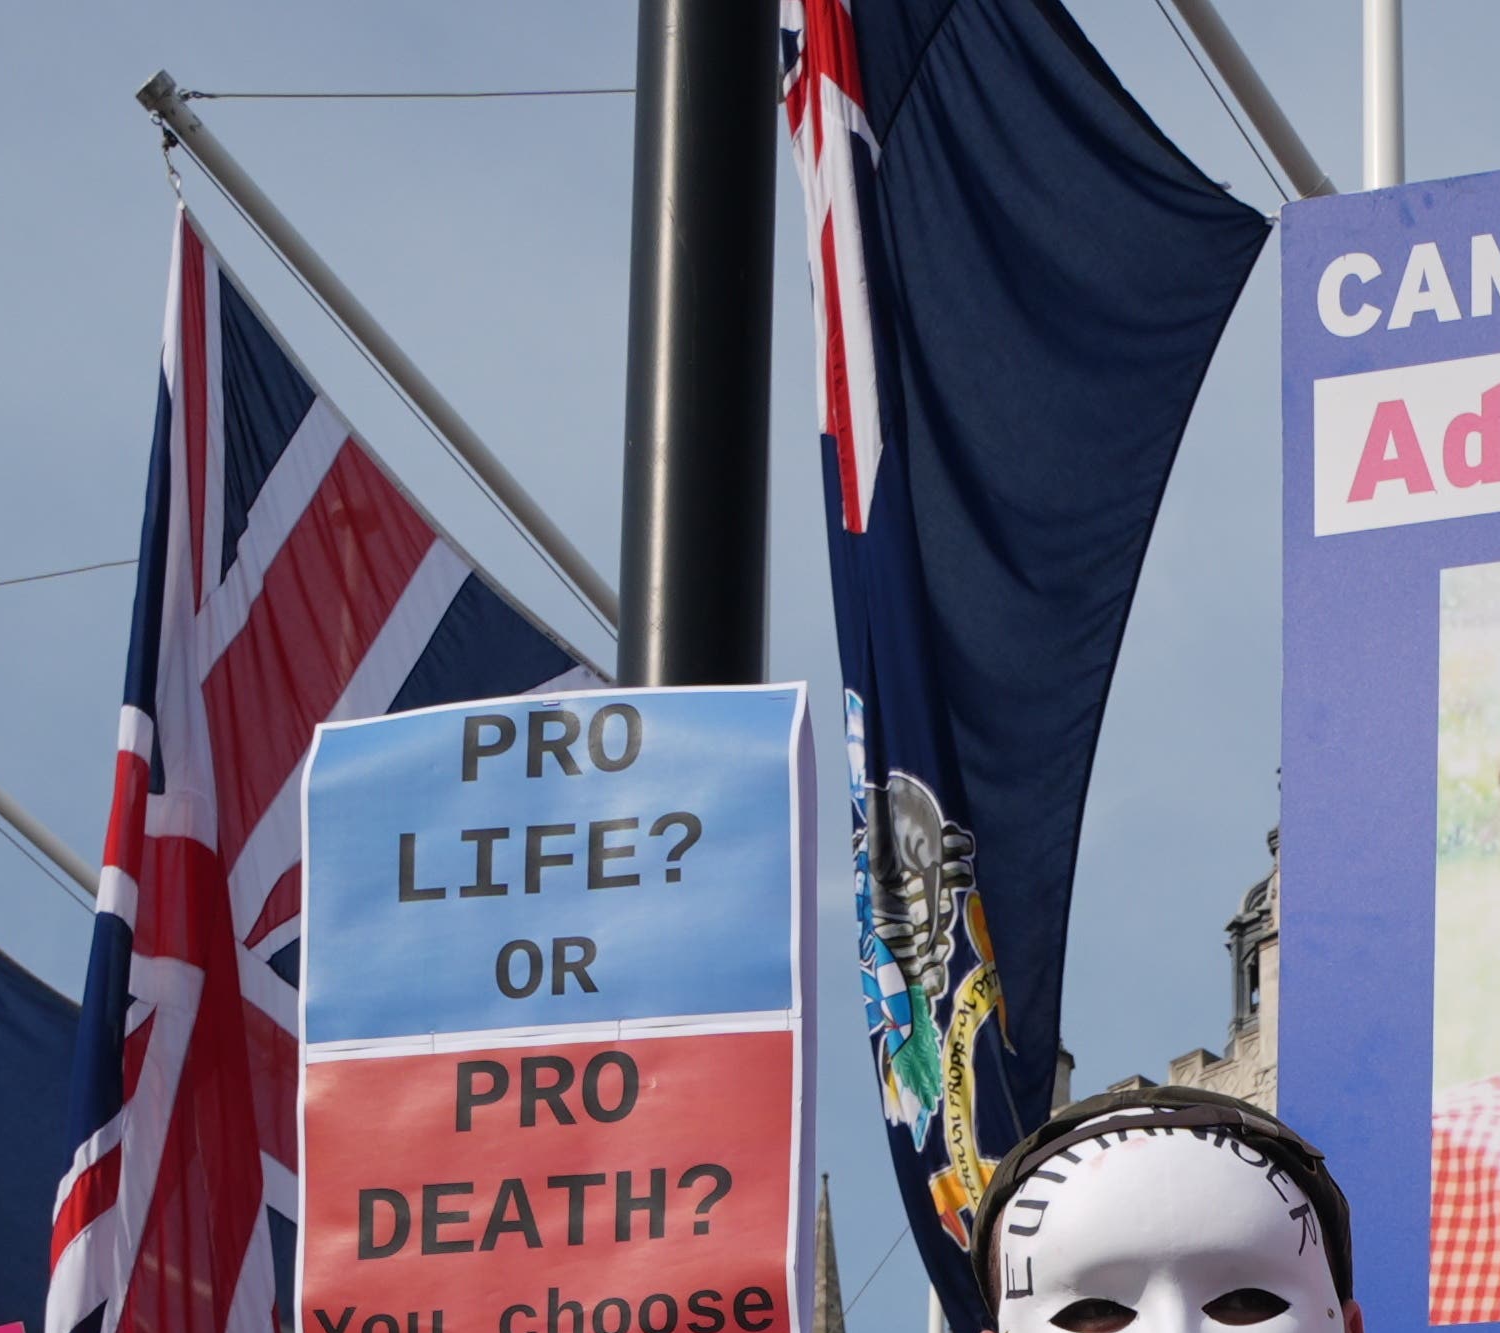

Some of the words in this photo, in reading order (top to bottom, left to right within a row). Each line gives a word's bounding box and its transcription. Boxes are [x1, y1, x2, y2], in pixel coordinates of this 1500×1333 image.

[461, 703, 643, 782] PRO
[398, 811, 702, 903] LIFE?
[495, 937, 598, 999] OR
[455, 1051, 639, 1132] PRO
[357, 1163, 733, 1260] DEATH?
